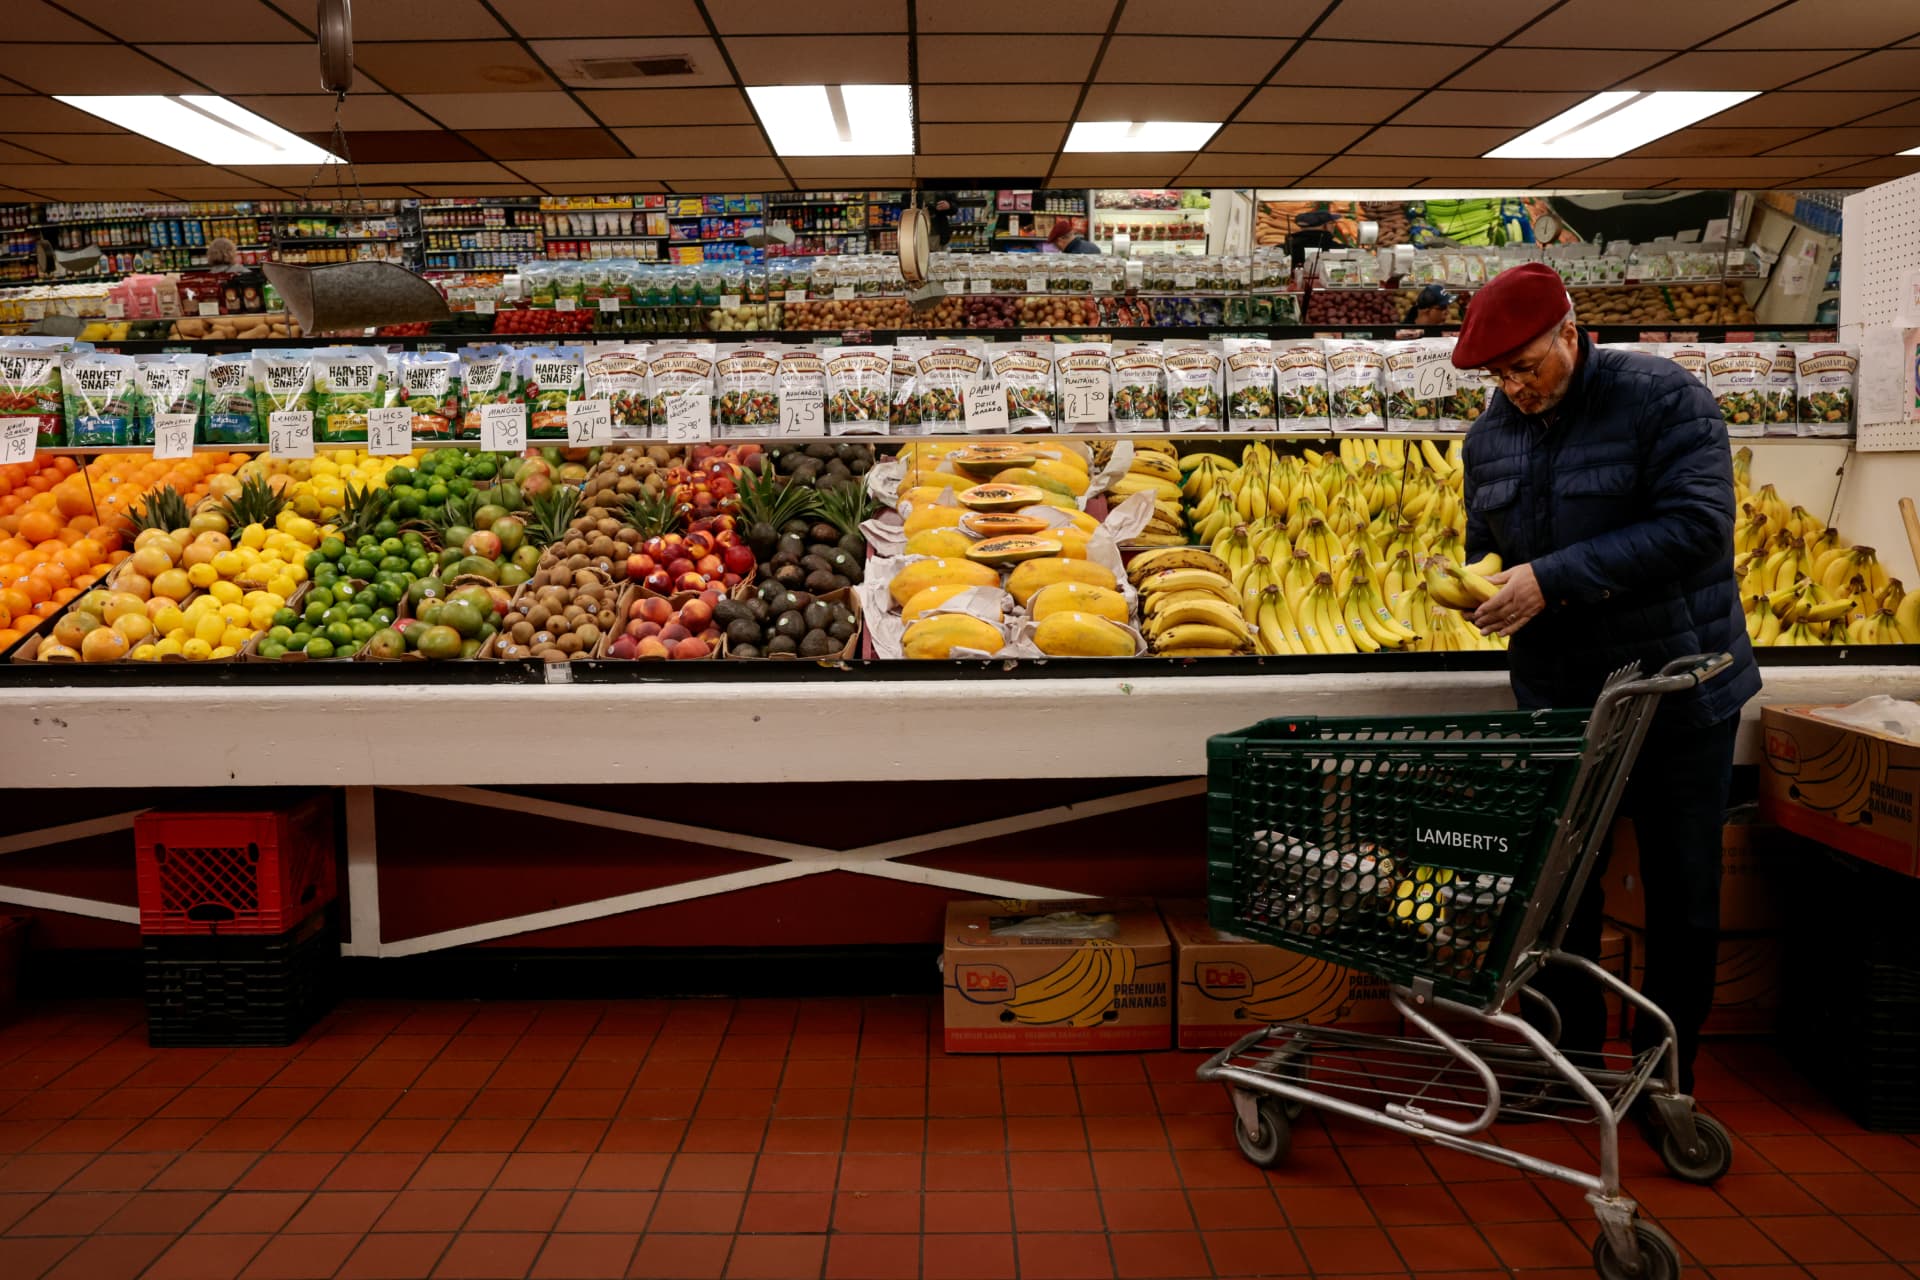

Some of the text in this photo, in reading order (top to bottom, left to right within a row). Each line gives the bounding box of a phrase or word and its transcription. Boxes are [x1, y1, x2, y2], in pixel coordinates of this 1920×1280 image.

[1416, 351, 1452, 363] BANANAS
[75, 369, 122, 381] HARVEST
[146, 369, 190, 381] HARST
[209, 365, 246, 379] HARVEST
[329, 366, 373, 377] HARVEST
[535, 364, 579, 375] HARVEST
[273, 378, 304, 388] SNAPS
[335, 376, 369, 386] SNPS
[540, 374, 572, 384] SNAPS
[488, 406, 523, 417] MANGOS
[1870, 781, 1913, 803] PREMIUM
[1869, 799, 1913, 823] BANANAS
[1416, 827, 1509, 853] LAMBERT'S
[966, 971, 1009, 988] Dole
[1205, 968, 1247, 985] Dole
[1350, 975, 1388, 985] PREMI
[1113, 982, 1167, 997] PREMIUM
[1349, 989, 1389, 1001] BANAN
[1113, 996, 1167, 1010] BANANAS
